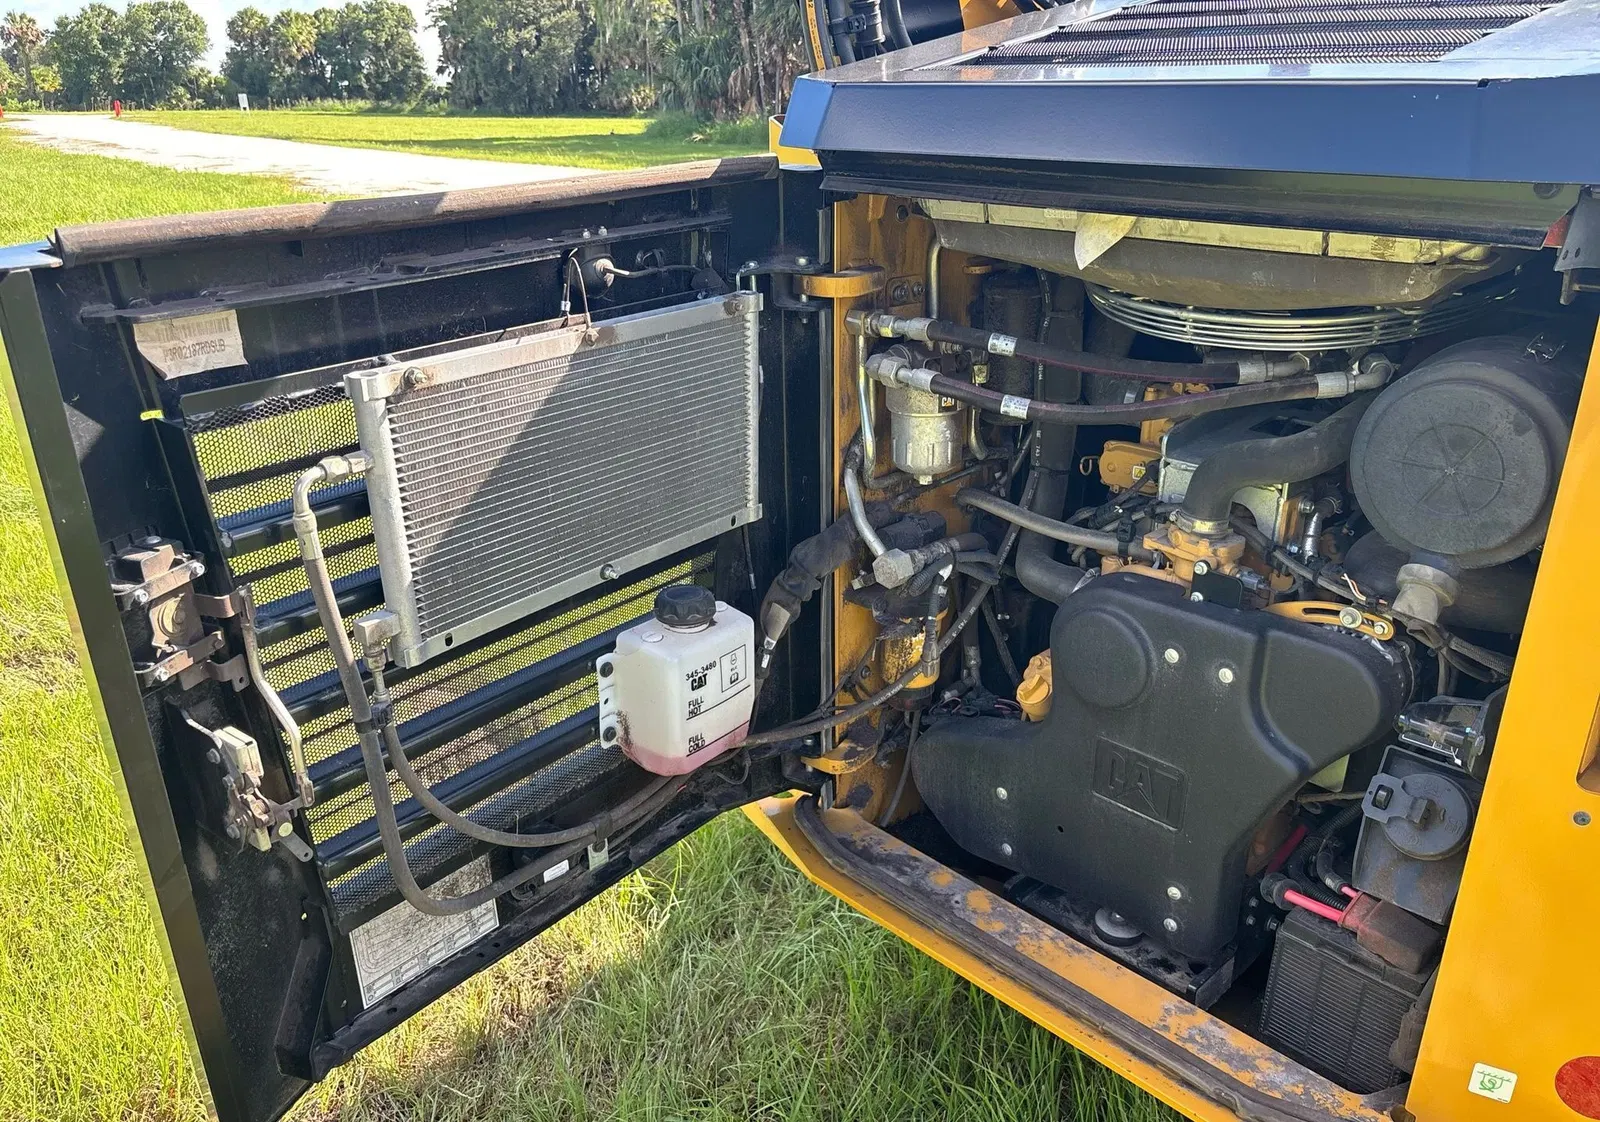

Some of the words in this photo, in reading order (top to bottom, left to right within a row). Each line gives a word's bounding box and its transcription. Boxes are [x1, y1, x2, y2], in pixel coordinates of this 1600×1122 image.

[686, 660, 717, 681] 345-3480
[691, 674, 708, 691] CAT
[688, 696, 704, 709] FULL
[688, 705, 701, 717] HOT
[688, 733, 704, 746] FULL
[688, 739, 706, 753] COLD
[1103, 746, 1181, 824] CAT
